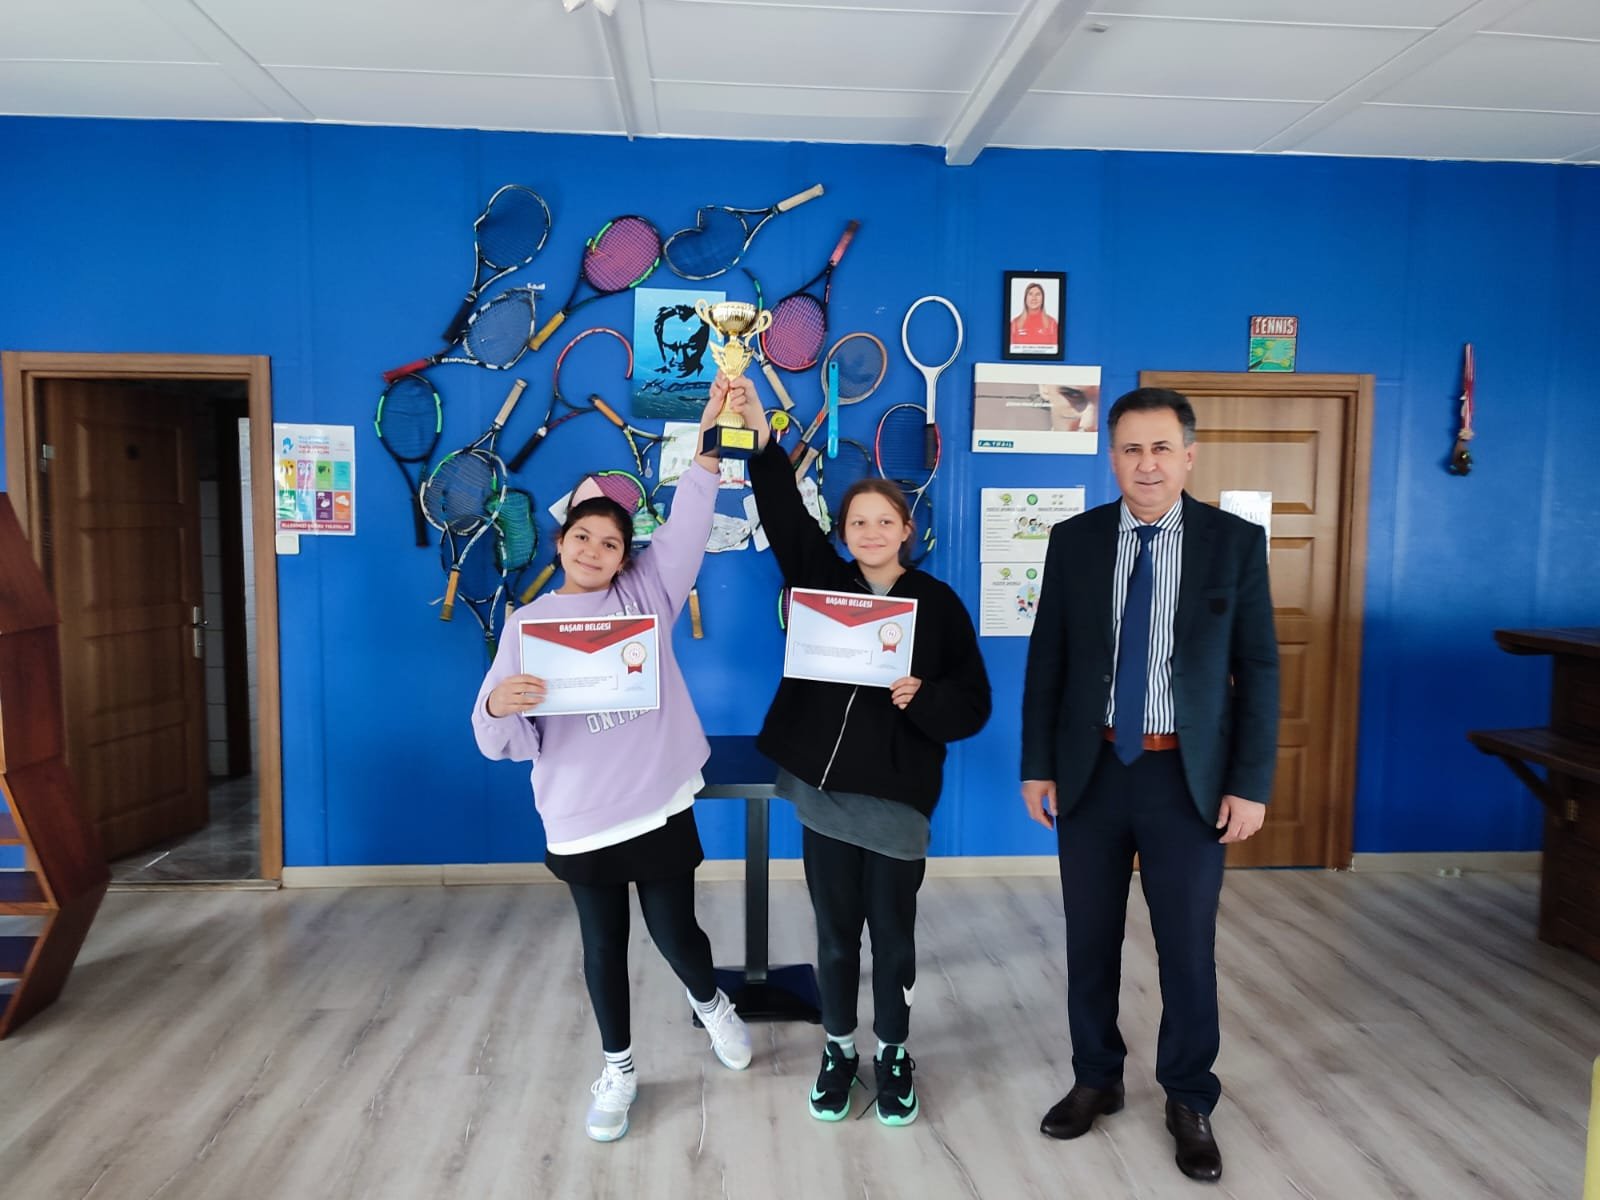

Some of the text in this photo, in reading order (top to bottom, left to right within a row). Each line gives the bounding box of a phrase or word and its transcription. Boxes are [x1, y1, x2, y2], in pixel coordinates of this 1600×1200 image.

[1255, 318, 1294, 334] TENNIS
[825, 596, 873, 609] BAŞARI BELGESİ
[559, 622, 612, 633] BAŞARI BELGESİ
